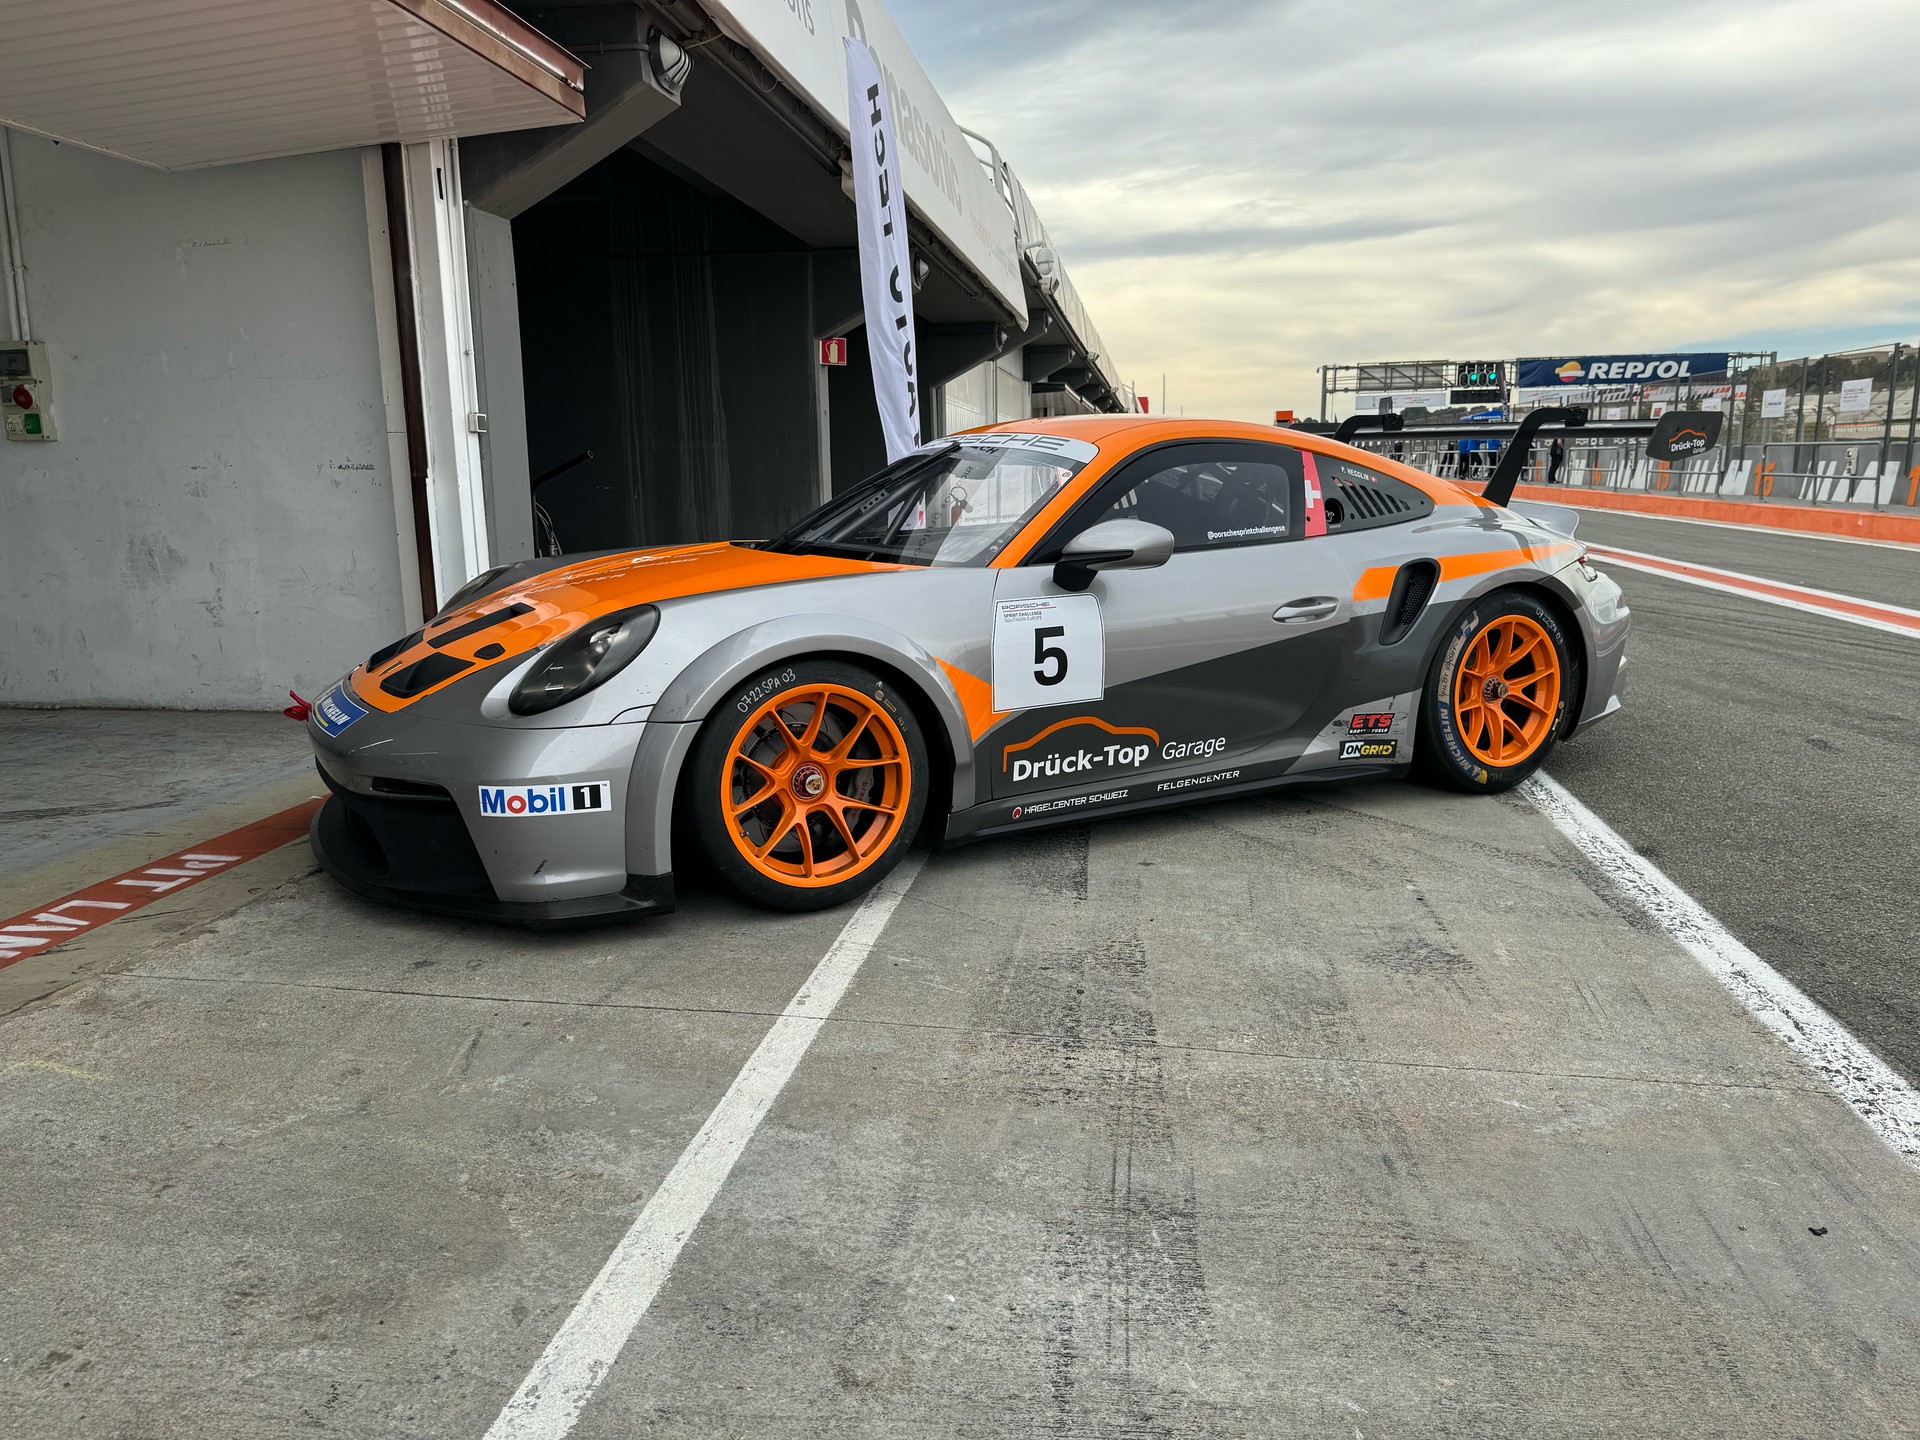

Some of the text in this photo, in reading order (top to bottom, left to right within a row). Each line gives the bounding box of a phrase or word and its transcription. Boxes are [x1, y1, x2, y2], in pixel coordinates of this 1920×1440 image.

[844, 0, 963, 217] Pnasonic
[1587, 360, 1691, 379] REPSOL
[1001, 601, 1051, 611] PORSCHE
[1033, 625, 1068, 686] 5
[781, 668, 796, 683] 03
[1352, 714, 1394, 728] ETS
[1012, 737, 1226, 782] Drück-Top Garage
[1157, 770, 1240, 792] FELGENCENTER
[481, 786, 566, 814] Mobil
[580, 786, 591, 808] 1
[1024, 789, 1129, 815] HAGELCENTER SCHWEIZ
